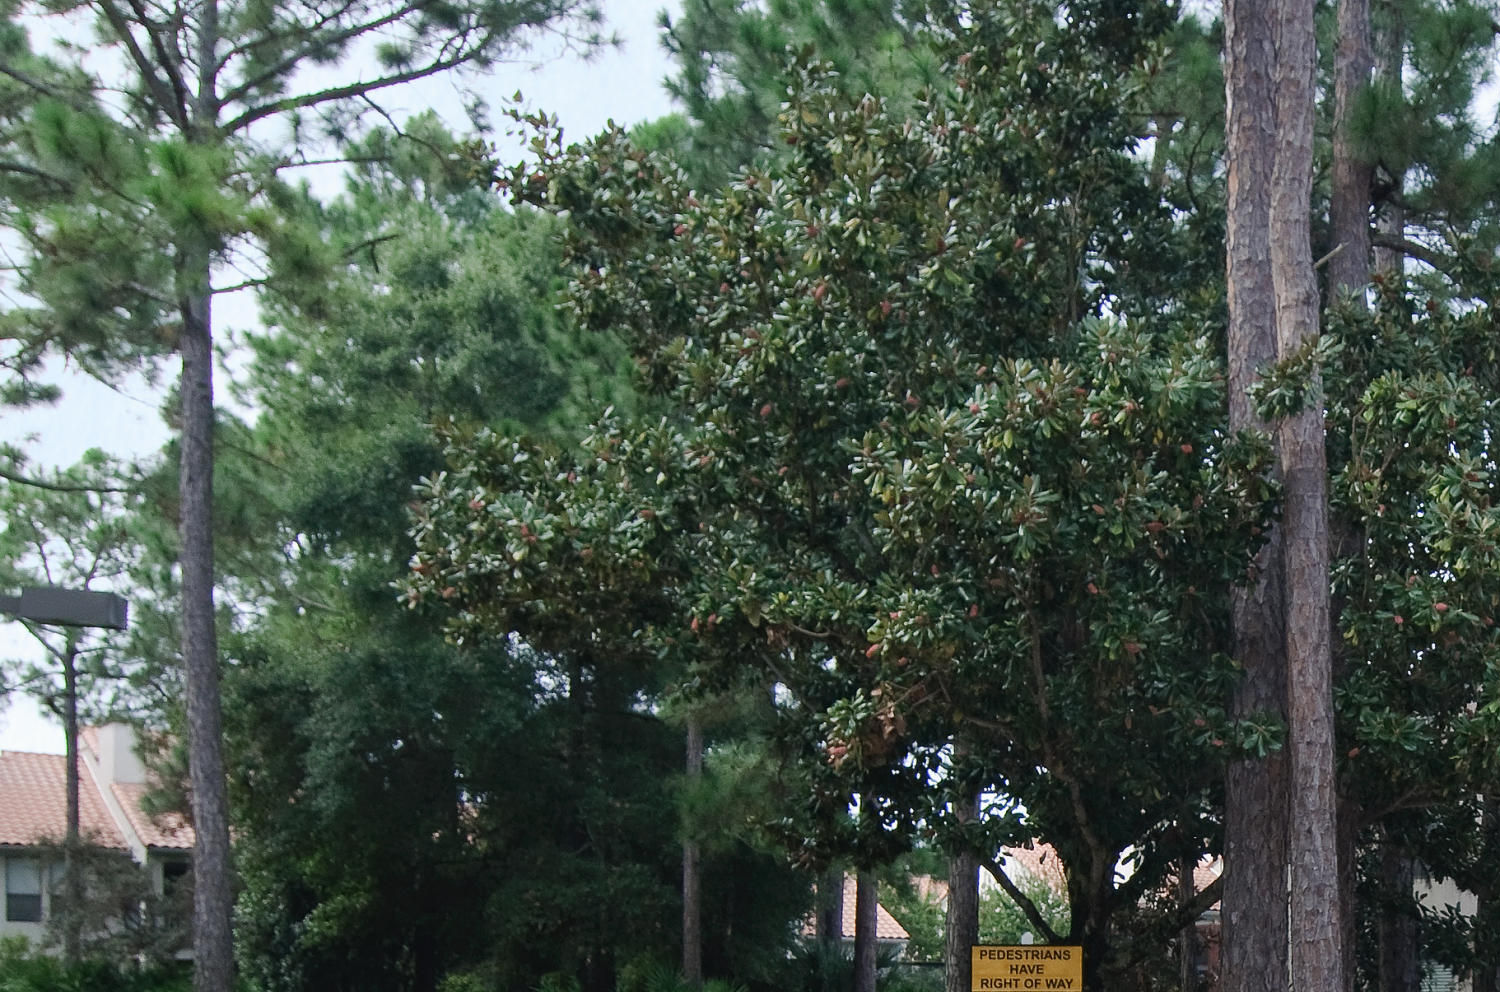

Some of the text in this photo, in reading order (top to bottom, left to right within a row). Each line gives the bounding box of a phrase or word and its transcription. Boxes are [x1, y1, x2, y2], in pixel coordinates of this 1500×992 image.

[980, 950, 1071, 960] PEDESTRIANS
[1009, 964, 1044, 975] HAVE
[980, 978, 1073, 988] RIGHT OF WAY
